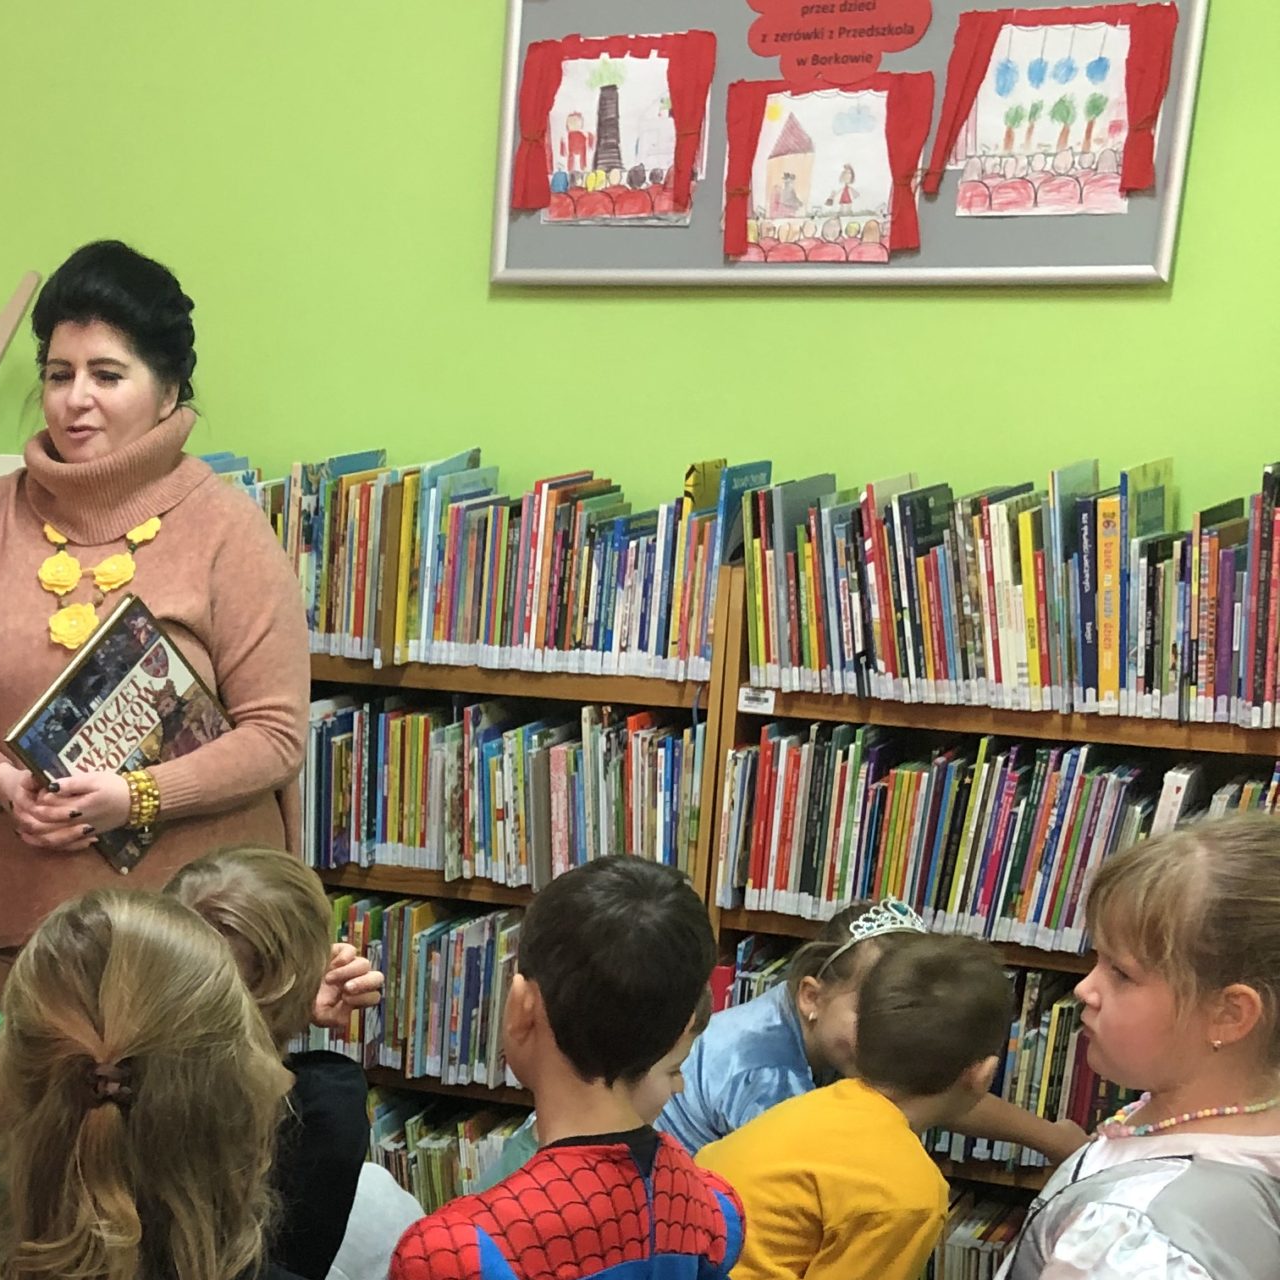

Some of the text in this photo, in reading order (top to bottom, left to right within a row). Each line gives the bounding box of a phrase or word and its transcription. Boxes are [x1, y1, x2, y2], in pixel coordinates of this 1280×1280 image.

[801, 0, 876, 17] przez dzieci
[761, 22, 915, 43] z zerówki z Przedszkola
[796, 52, 873, 66] w Borkowie
[79, 675, 143, 747] POCZET
